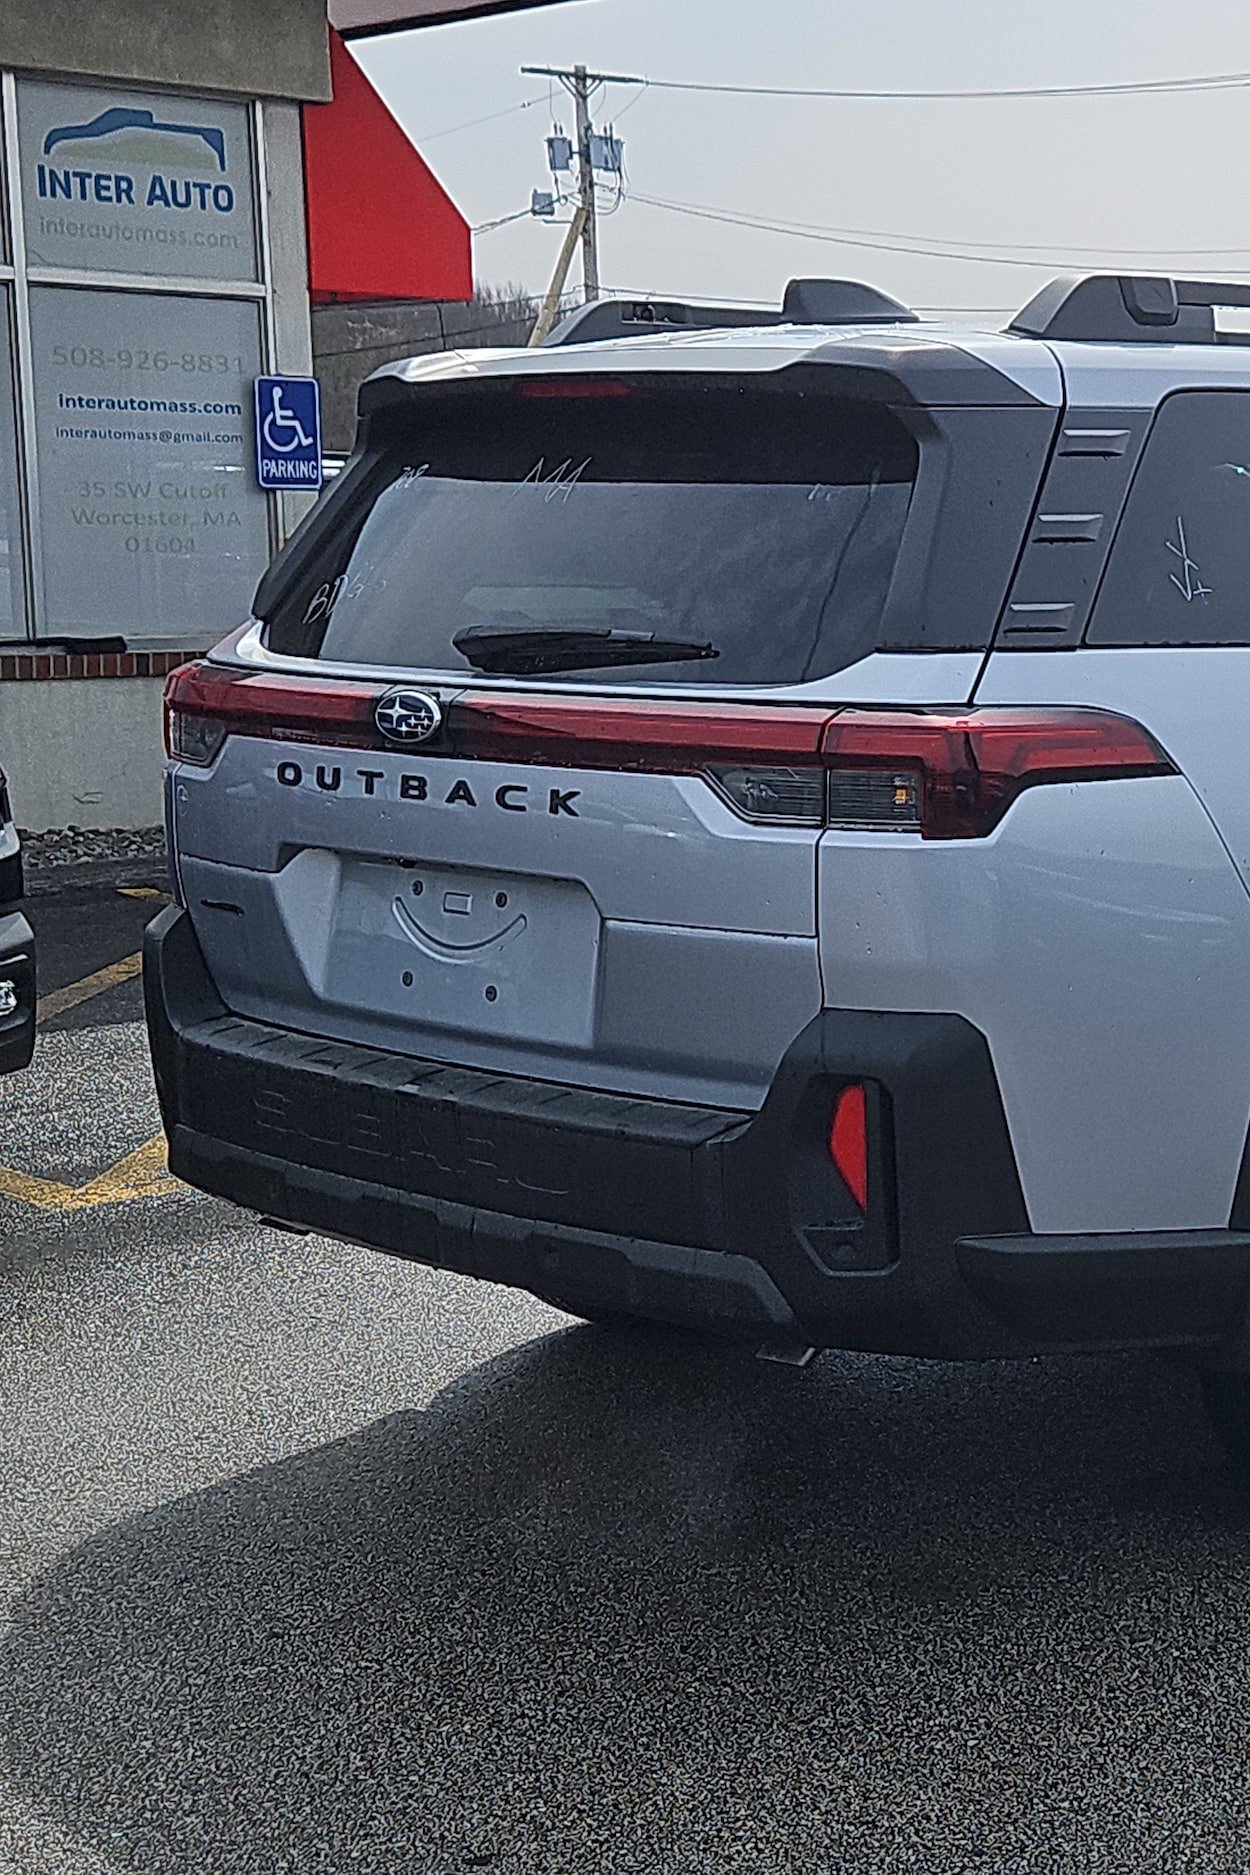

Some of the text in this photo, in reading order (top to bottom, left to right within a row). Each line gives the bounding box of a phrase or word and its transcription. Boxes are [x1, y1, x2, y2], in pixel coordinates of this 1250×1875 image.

[37, 164, 234, 213] INTER AUTO
[40, 216, 240, 249] interautomass.com
[51, 344, 247, 376] 508-926-8831
[262, 459, 318, 480] PARKING
[114, 481, 151, 499] SW
[203, 510, 242, 527] MA
[276, 760, 582, 818] OUTBACK
